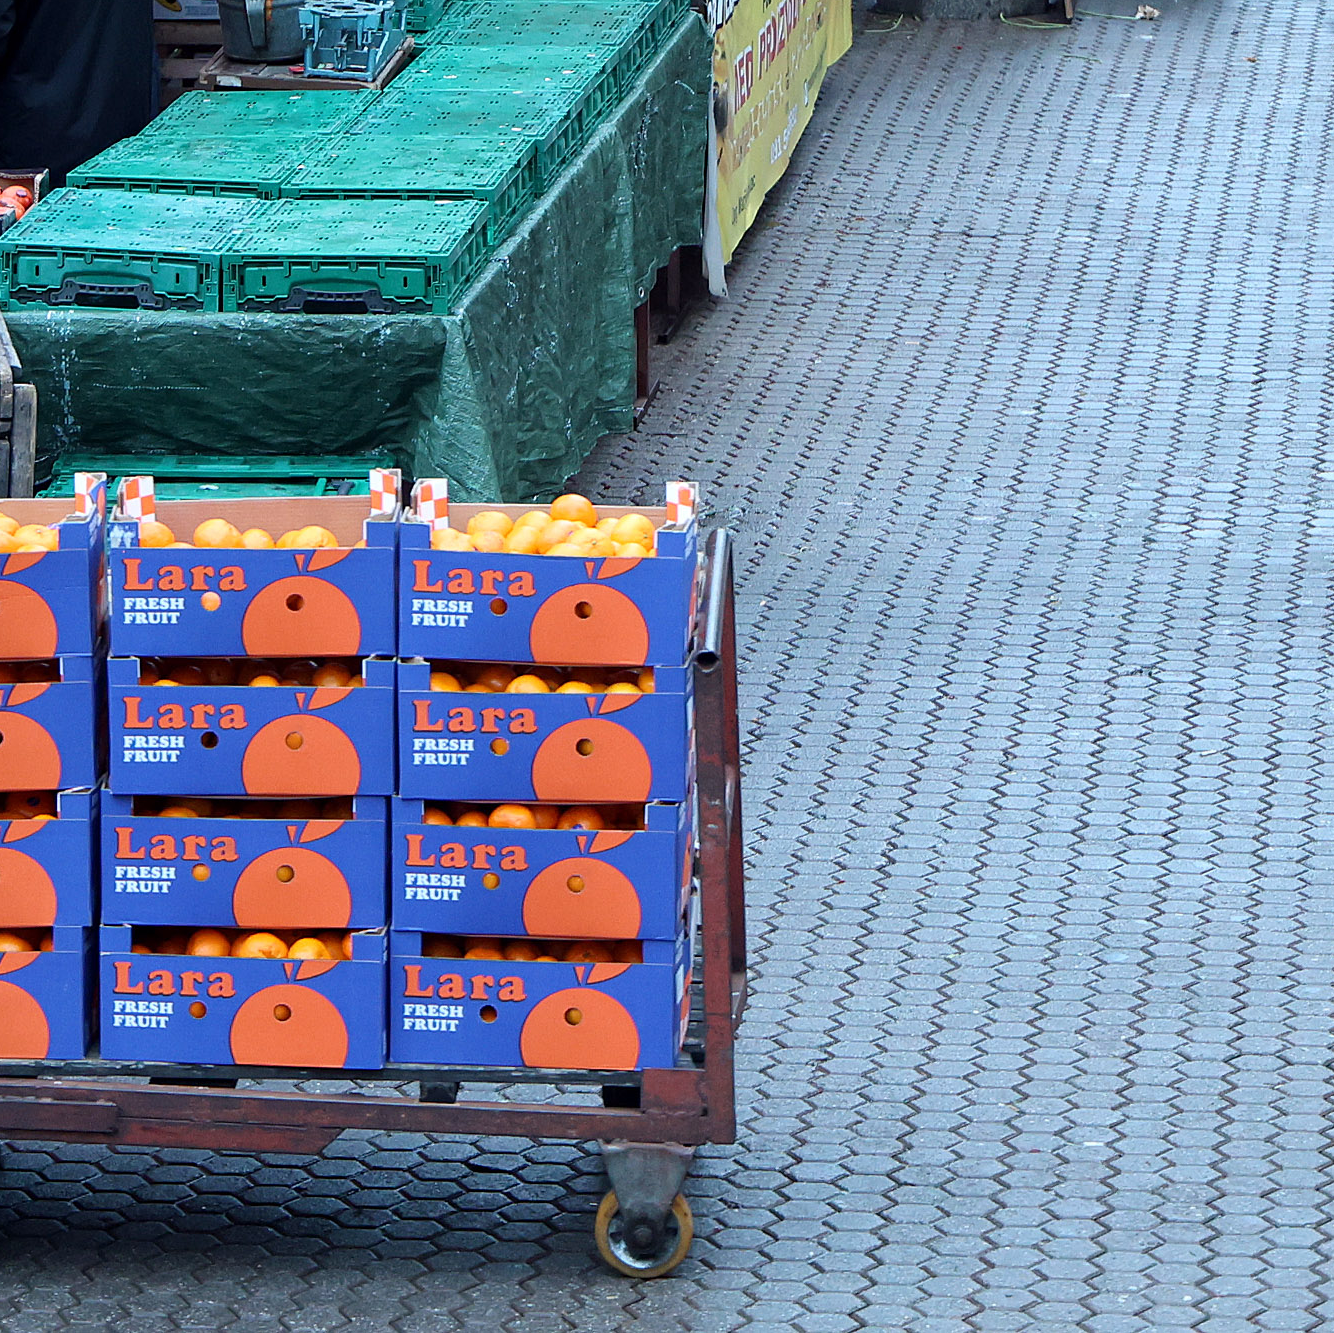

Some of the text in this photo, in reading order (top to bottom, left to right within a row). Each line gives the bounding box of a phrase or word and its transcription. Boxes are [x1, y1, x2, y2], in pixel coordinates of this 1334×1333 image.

[124, 558, 247, 590] Lara
[414, 561, 536, 596] Lara
[123, 598, 184, 609] FRESH
[412, 599, 473, 613] FRESH
[123, 612, 181, 623] FRUIT
[412, 613, 469, 626] FRUIT
[124, 697, 247, 729] Lara
[415, 701, 537, 733] Lara
[123, 736, 184, 748] FRESH
[413, 739, 474, 751] FRESH
[123, 750, 181, 762] FRUIT
[413, 753, 470, 765] FRUIT
[116, 827, 239, 861] Lara
[407, 835, 528, 870] Lara
[115, 866, 175, 878] FRESH
[115, 880, 172, 892] FRUIT
[405, 873, 466, 887] FRESH
[405, 887, 462, 900] FRUIT
[115, 962, 236, 997] Lara
[405, 966, 526, 1001] Lara
[113, 1000, 173, 1014] FRESH
[404, 1004, 463, 1017] FRESH
[113, 1015, 169, 1028] FRUIT
[404, 1018, 460, 1032] FRUIT
